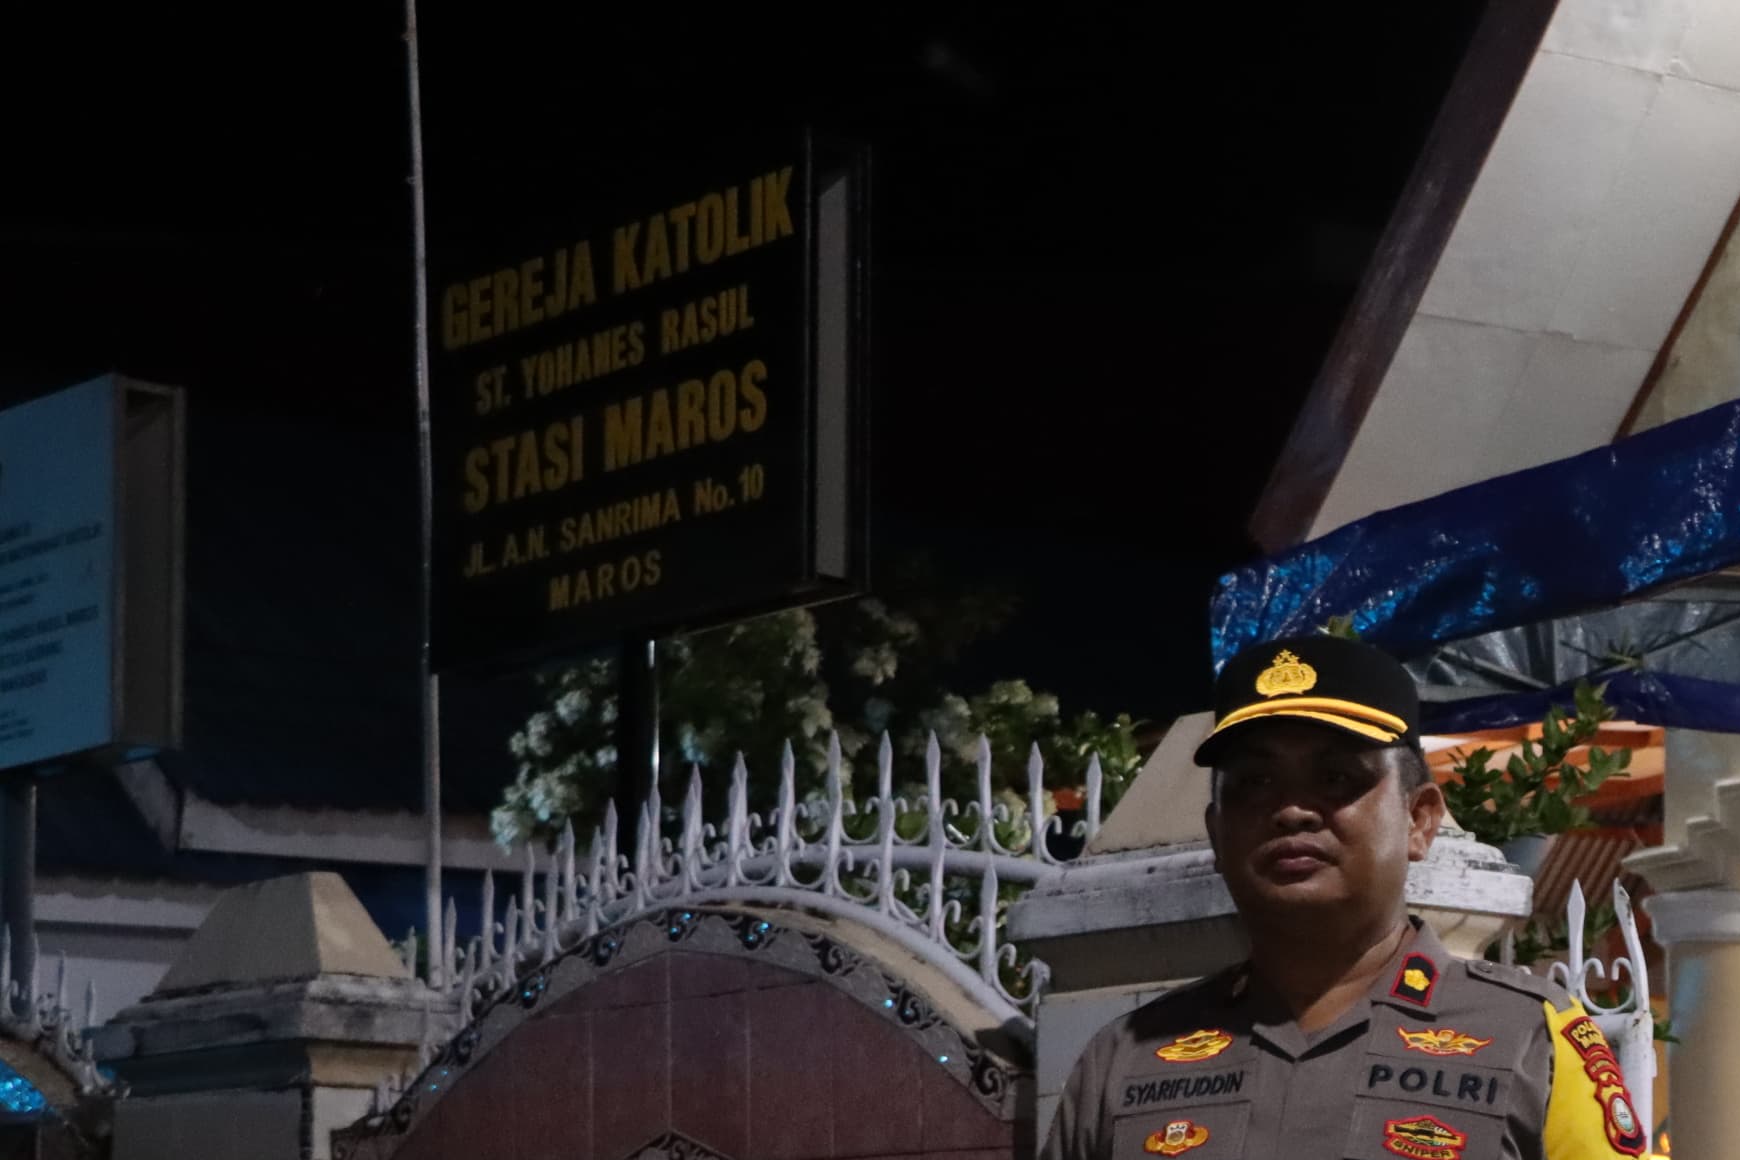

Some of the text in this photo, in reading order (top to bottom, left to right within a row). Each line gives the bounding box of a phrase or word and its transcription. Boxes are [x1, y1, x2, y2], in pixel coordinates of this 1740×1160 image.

[442, 165, 795, 351] GEREJA KATOLIK
[474, 364, 512, 416] ST.
[660, 283, 755, 355] RASUL
[464, 358, 770, 514] STASI MAROS
[560, 487, 683, 553] SANRIMA
[693, 477, 735, 517] No.
[738, 462, 766, 502] 10
[547, 549, 663, 613] MAROS
[1122, 1070, 1246, 1107] SYARIFUDDIN
[1367, 1064, 1498, 1105] POLRI
